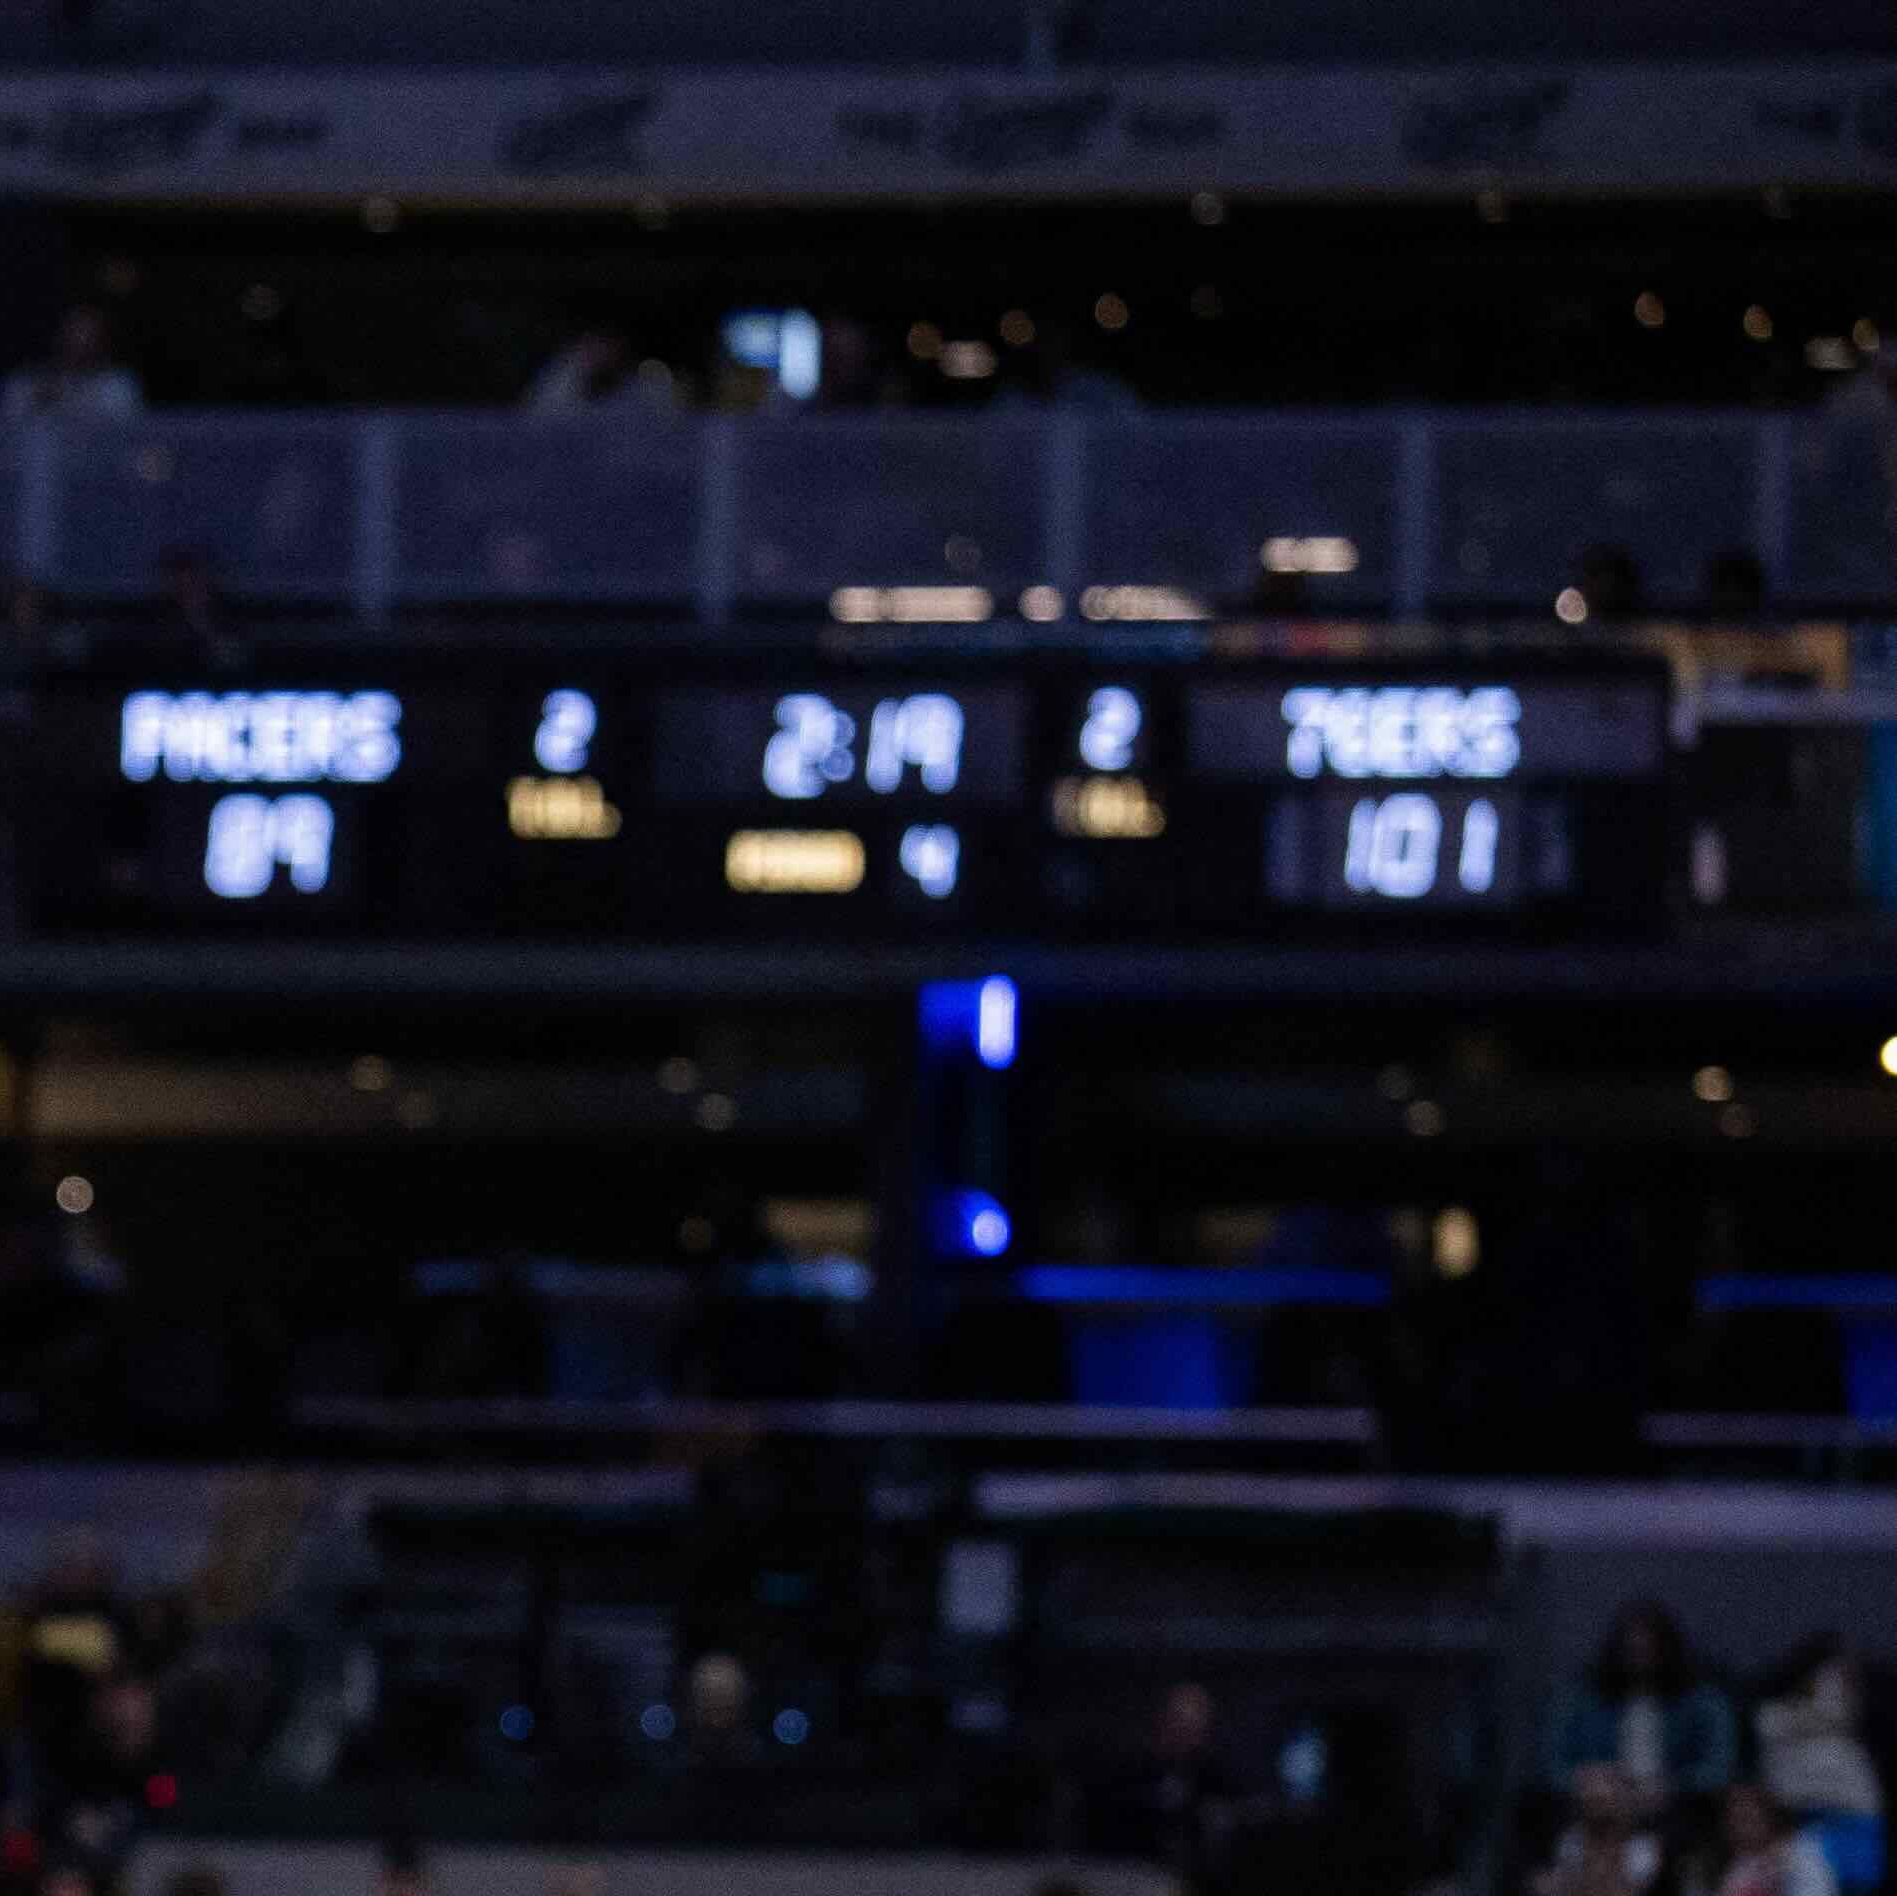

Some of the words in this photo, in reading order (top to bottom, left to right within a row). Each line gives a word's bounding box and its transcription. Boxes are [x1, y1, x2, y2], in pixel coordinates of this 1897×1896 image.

[120, 689, 402, 783] PACERS
[534, 689, 597, 773] 2
[762, 692, 964, 800] 2:19
[1079, 686, 1142, 771] 2
[1280, 685, 1521, 779] 76ERS
[1344, 792, 1500, 899] 101
